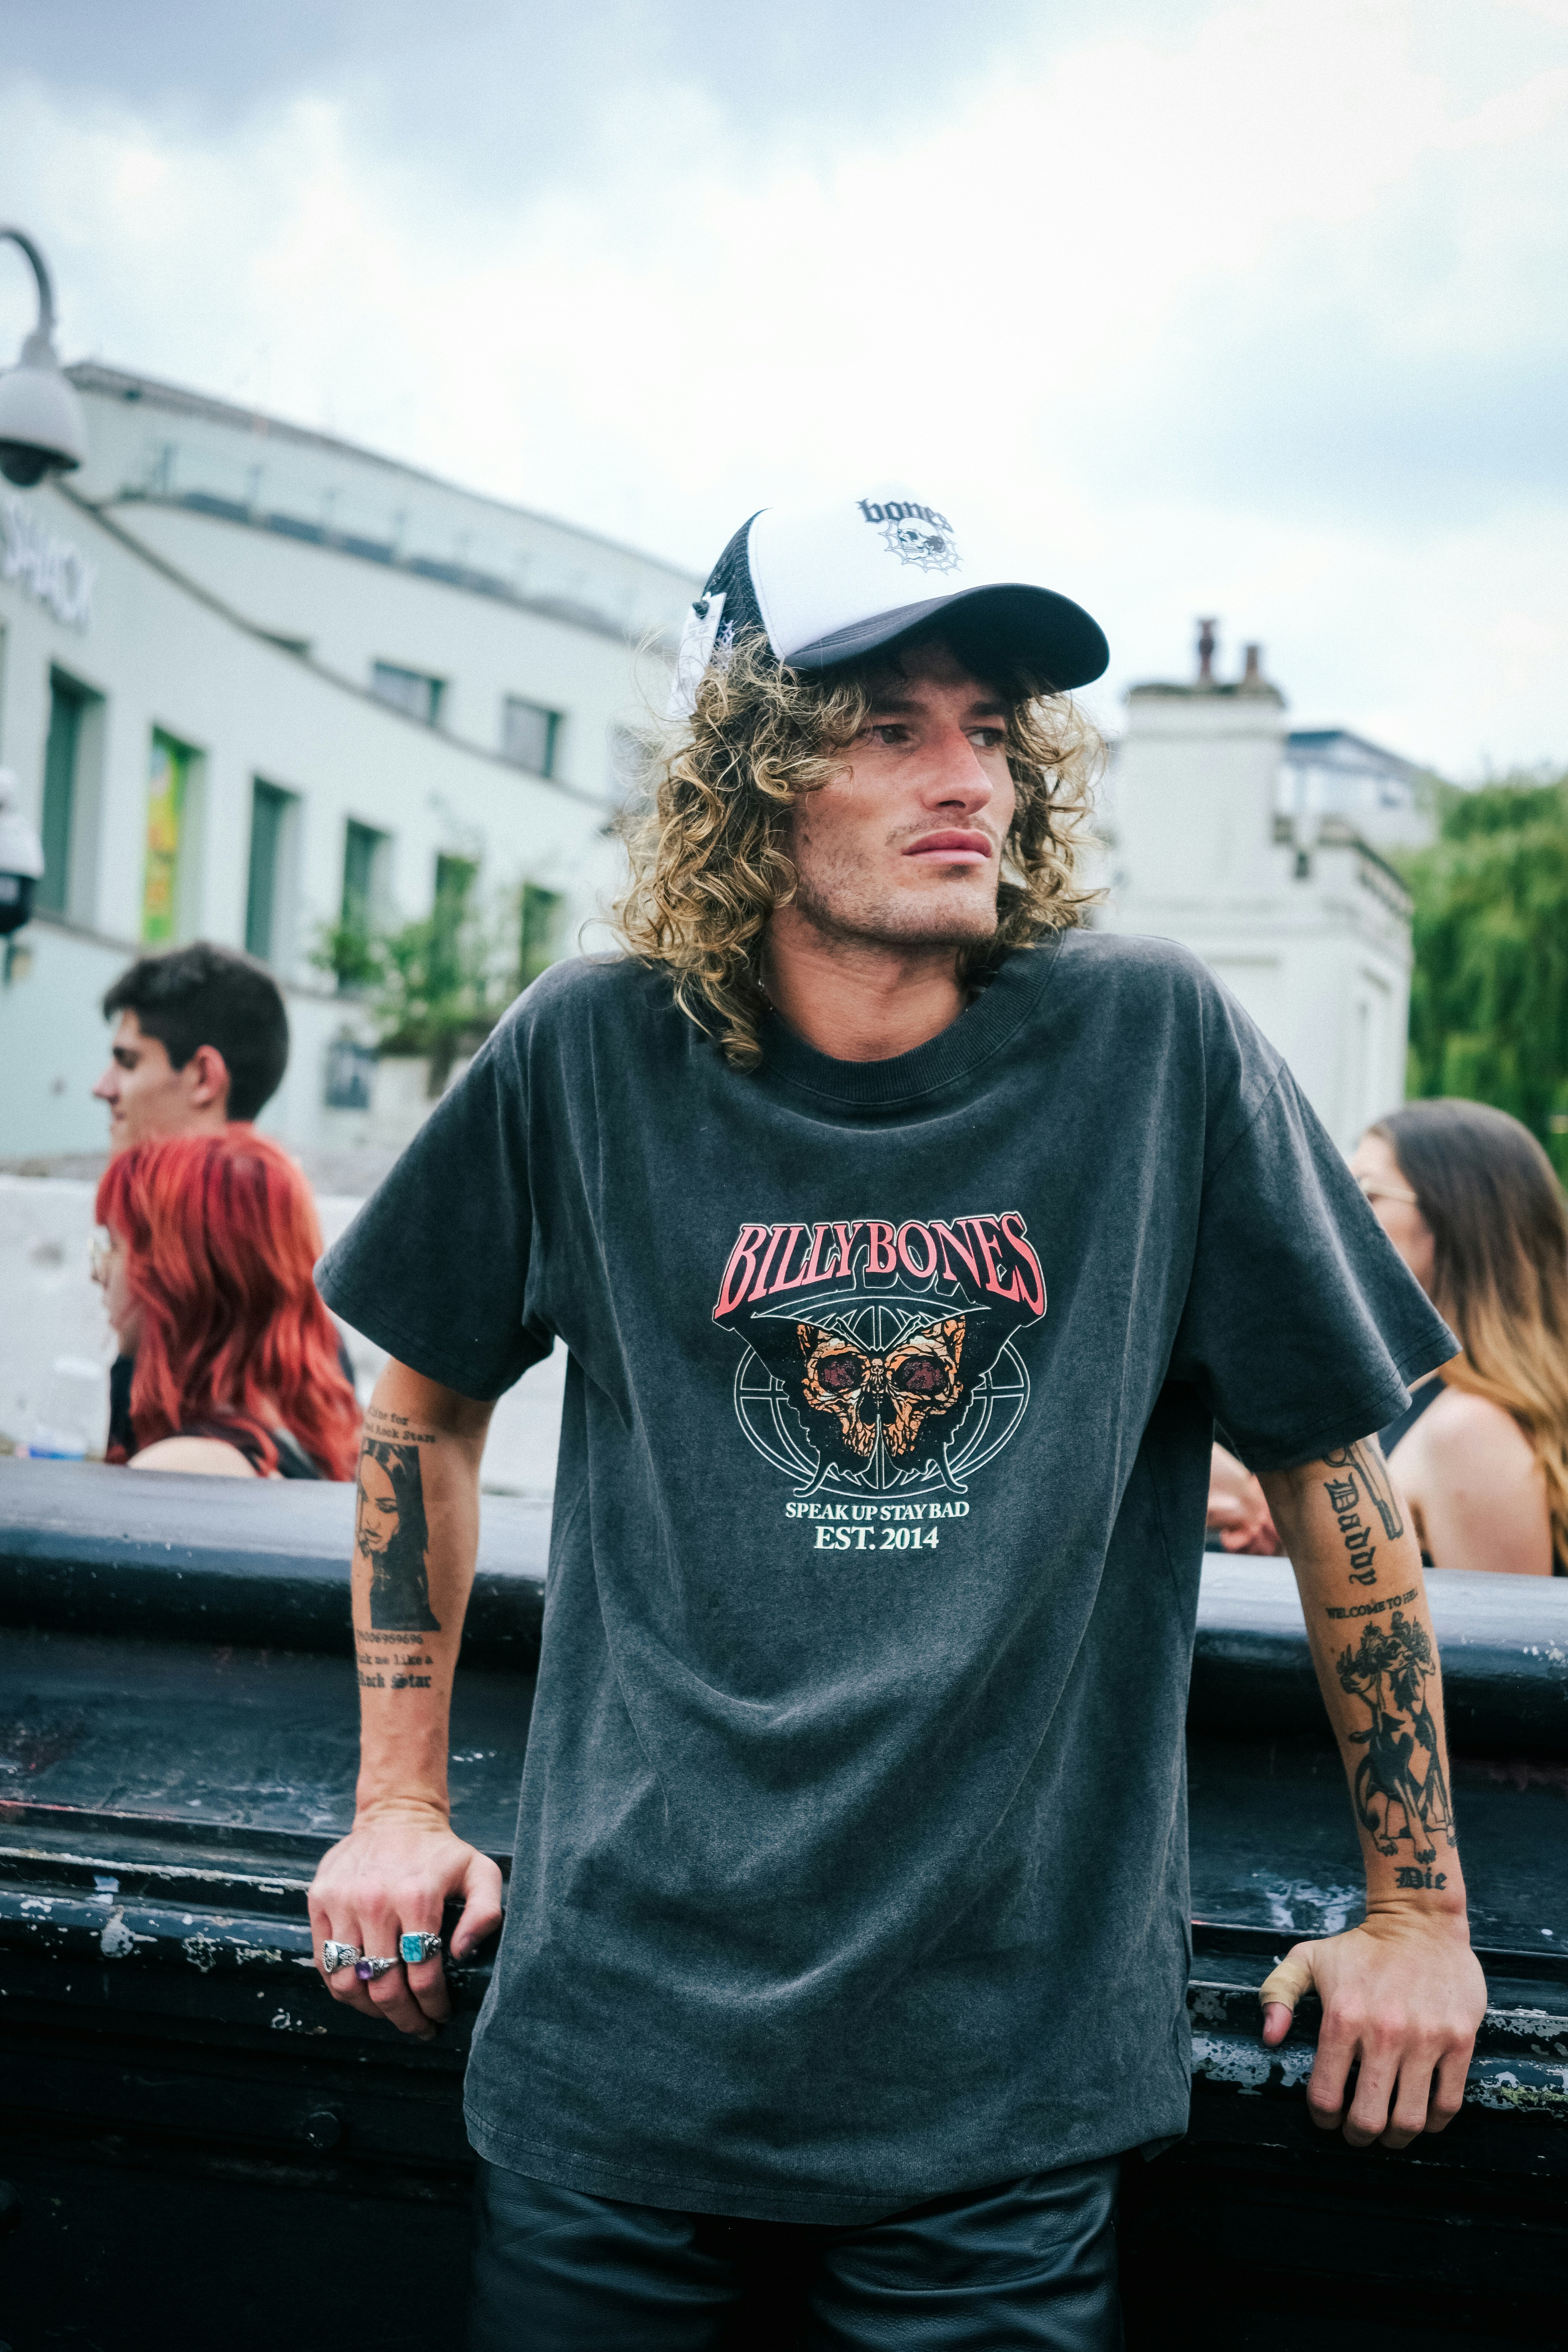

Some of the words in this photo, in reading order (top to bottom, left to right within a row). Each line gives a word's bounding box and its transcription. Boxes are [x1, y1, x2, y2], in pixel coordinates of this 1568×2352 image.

[785, 1502, 849, 1521] SPEAK
[851, 1505, 878, 1521] UP
[879, 1504, 928, 1521] STAY
[928, 1501, 970, 1519] BAD
[814, 1525, 876, 1550] EST.
[879, 1526, 940, 1550] 2014
[1325, 1601, 1386, 1620] WELCOME
[1386, 1595, 1402, 1610] TO
[1394, 1867, 1447, 1890] Die
